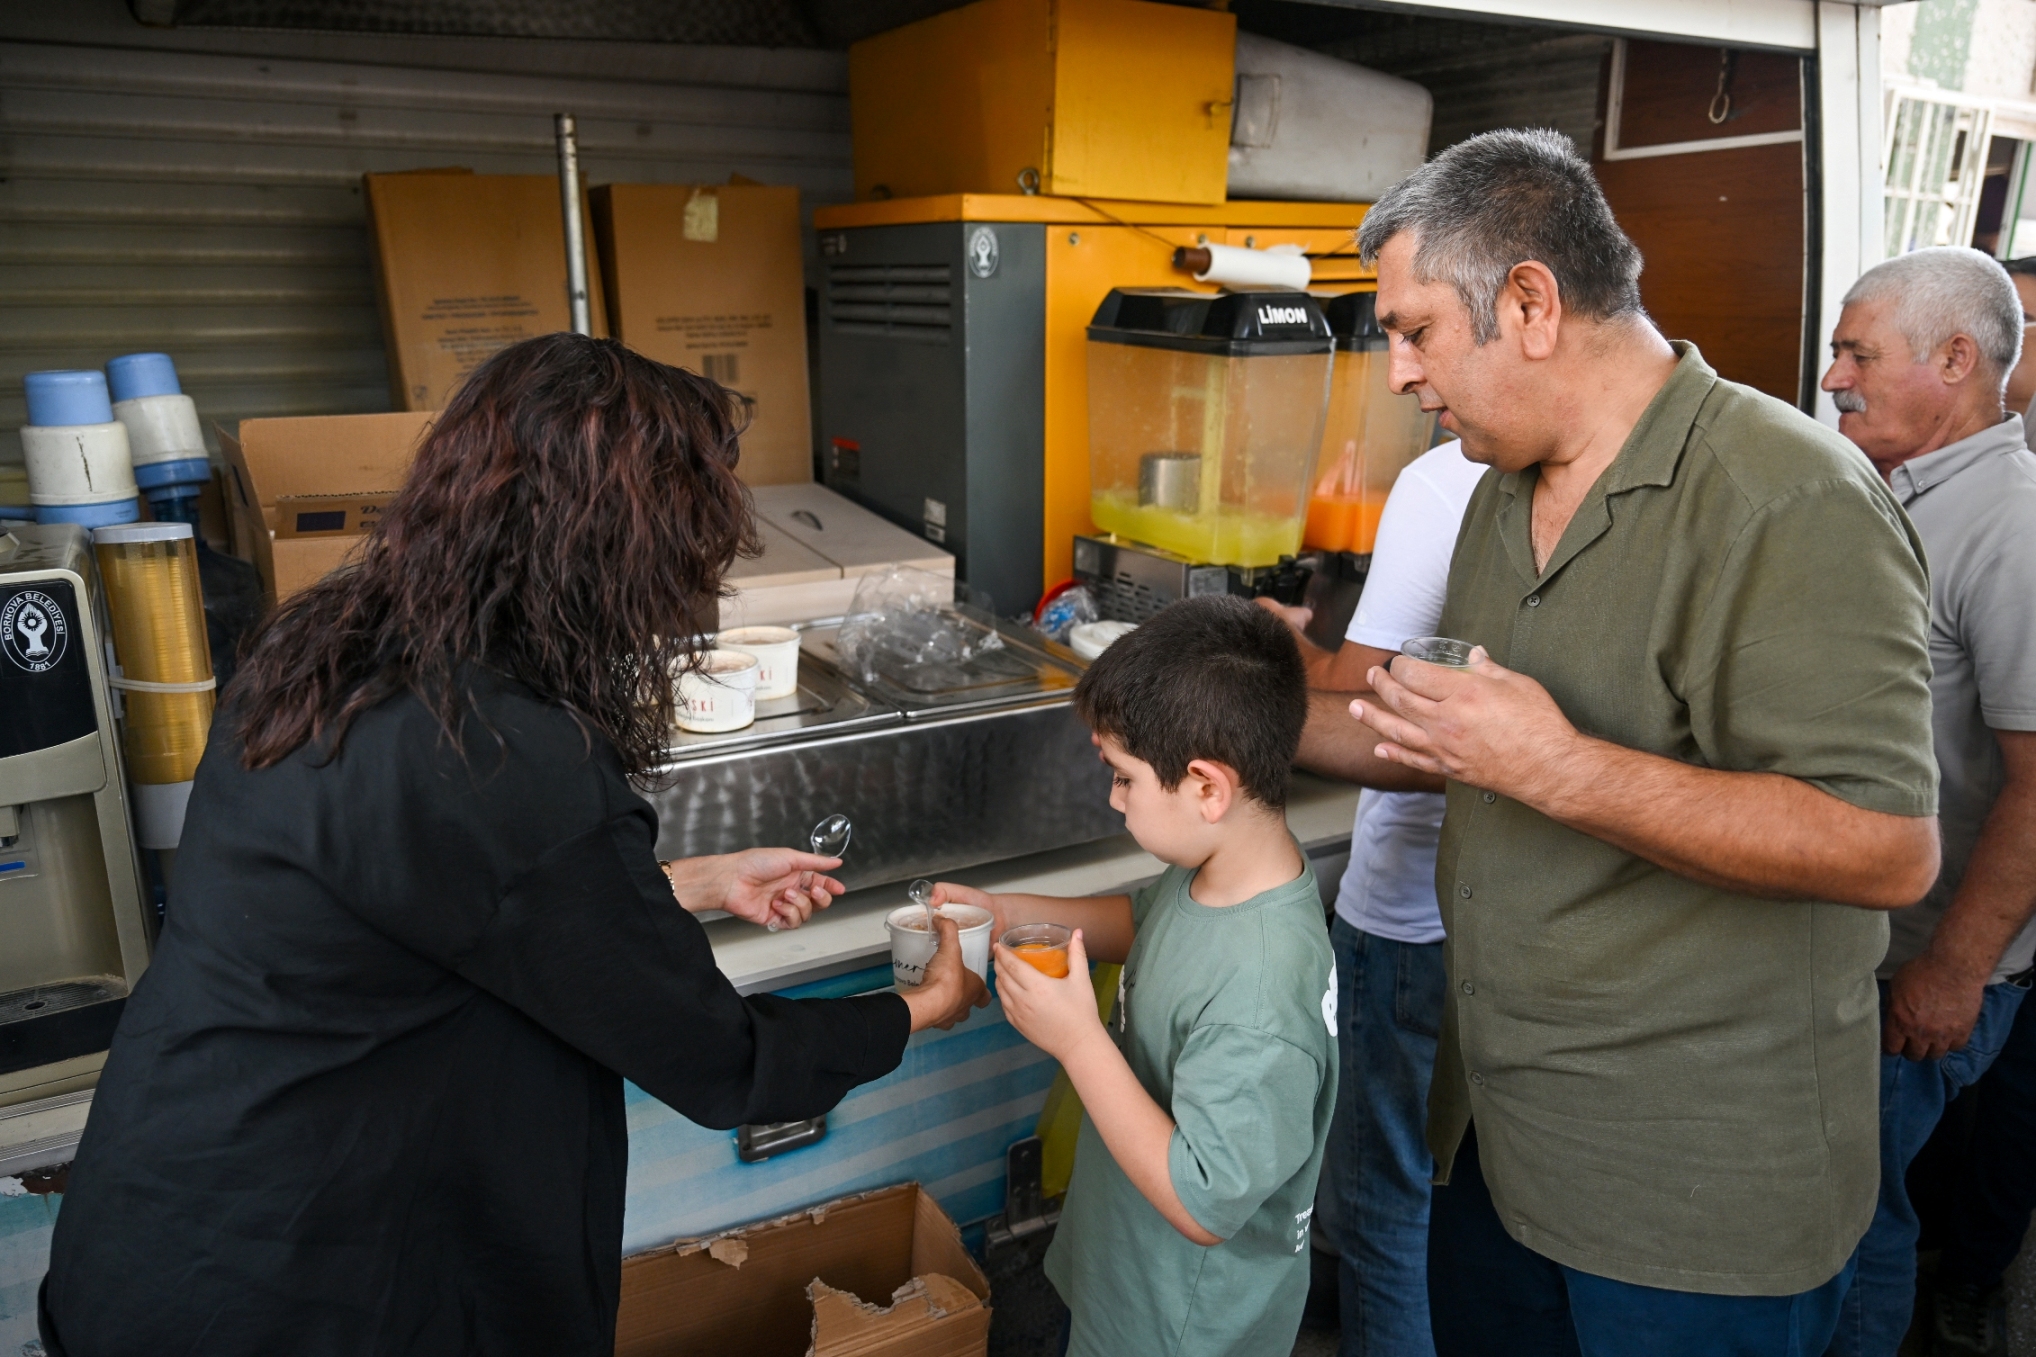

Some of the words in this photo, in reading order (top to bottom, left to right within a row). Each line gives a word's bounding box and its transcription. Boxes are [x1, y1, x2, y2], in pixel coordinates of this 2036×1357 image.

[1258, 304, 1308, 324] LİMON
[2, 596, 24, 641] BORNOVA
[29, 661, 51, 671] 1881
